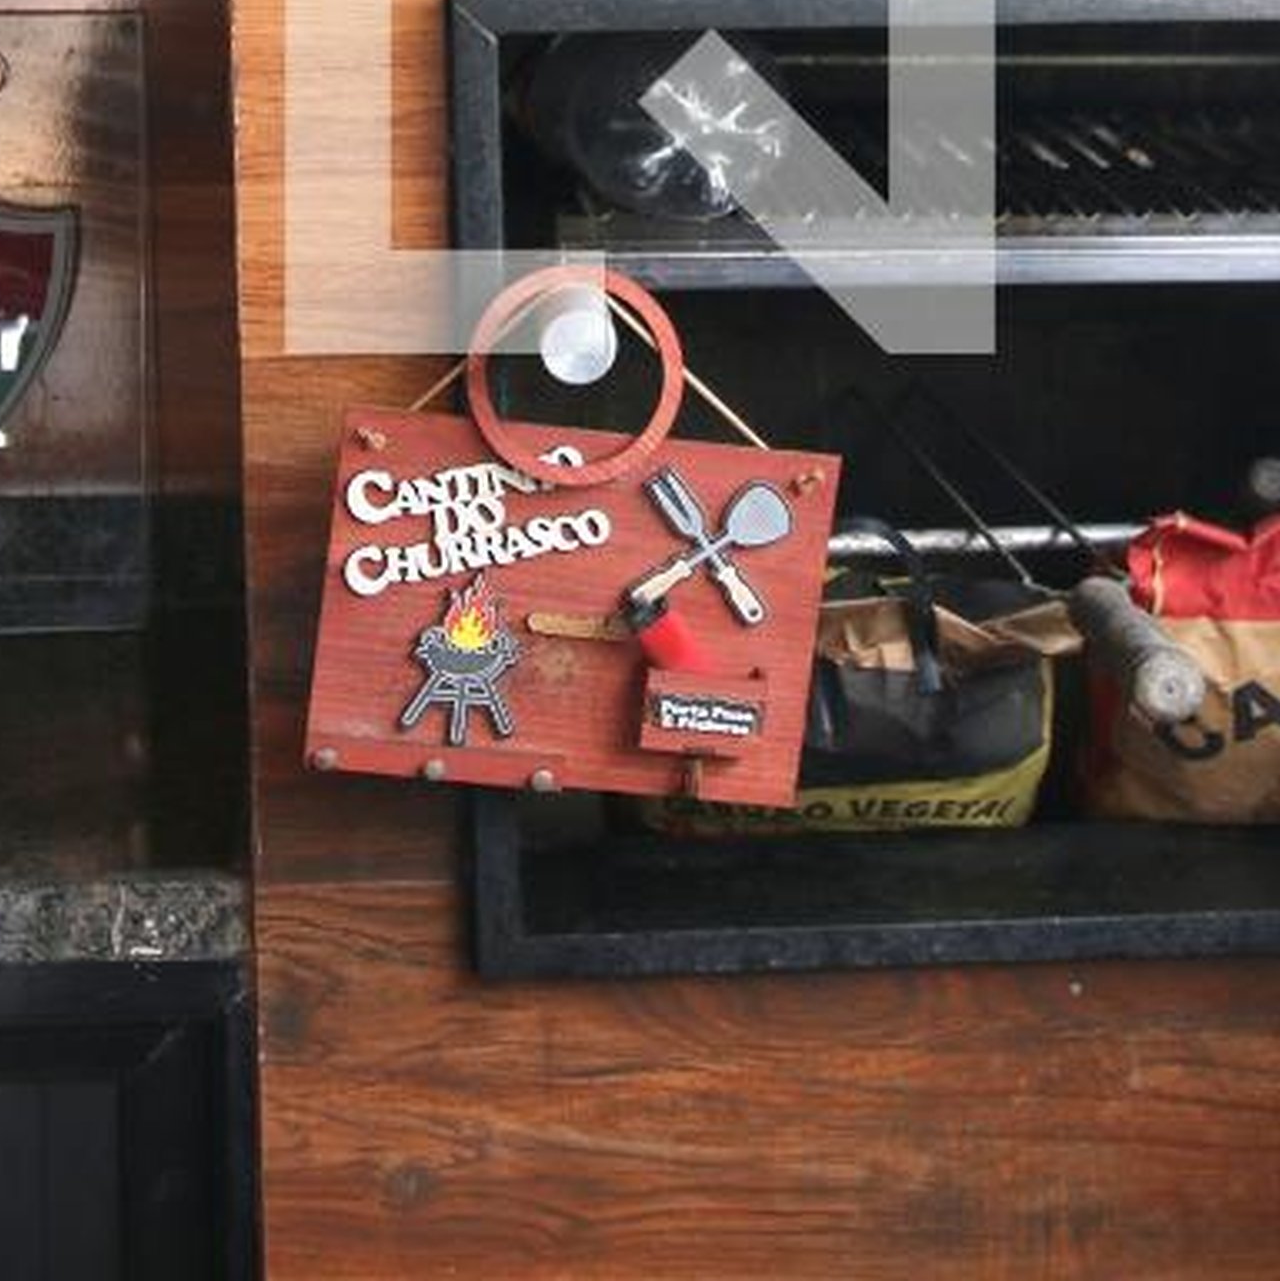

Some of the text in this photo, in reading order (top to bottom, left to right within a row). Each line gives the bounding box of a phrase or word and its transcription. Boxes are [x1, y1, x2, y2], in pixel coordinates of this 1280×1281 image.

[347, 446, 586, 523] CANTINO
[434, 496, 507, 543] DO
[344, 509, 612, 595] CHURRASCO
